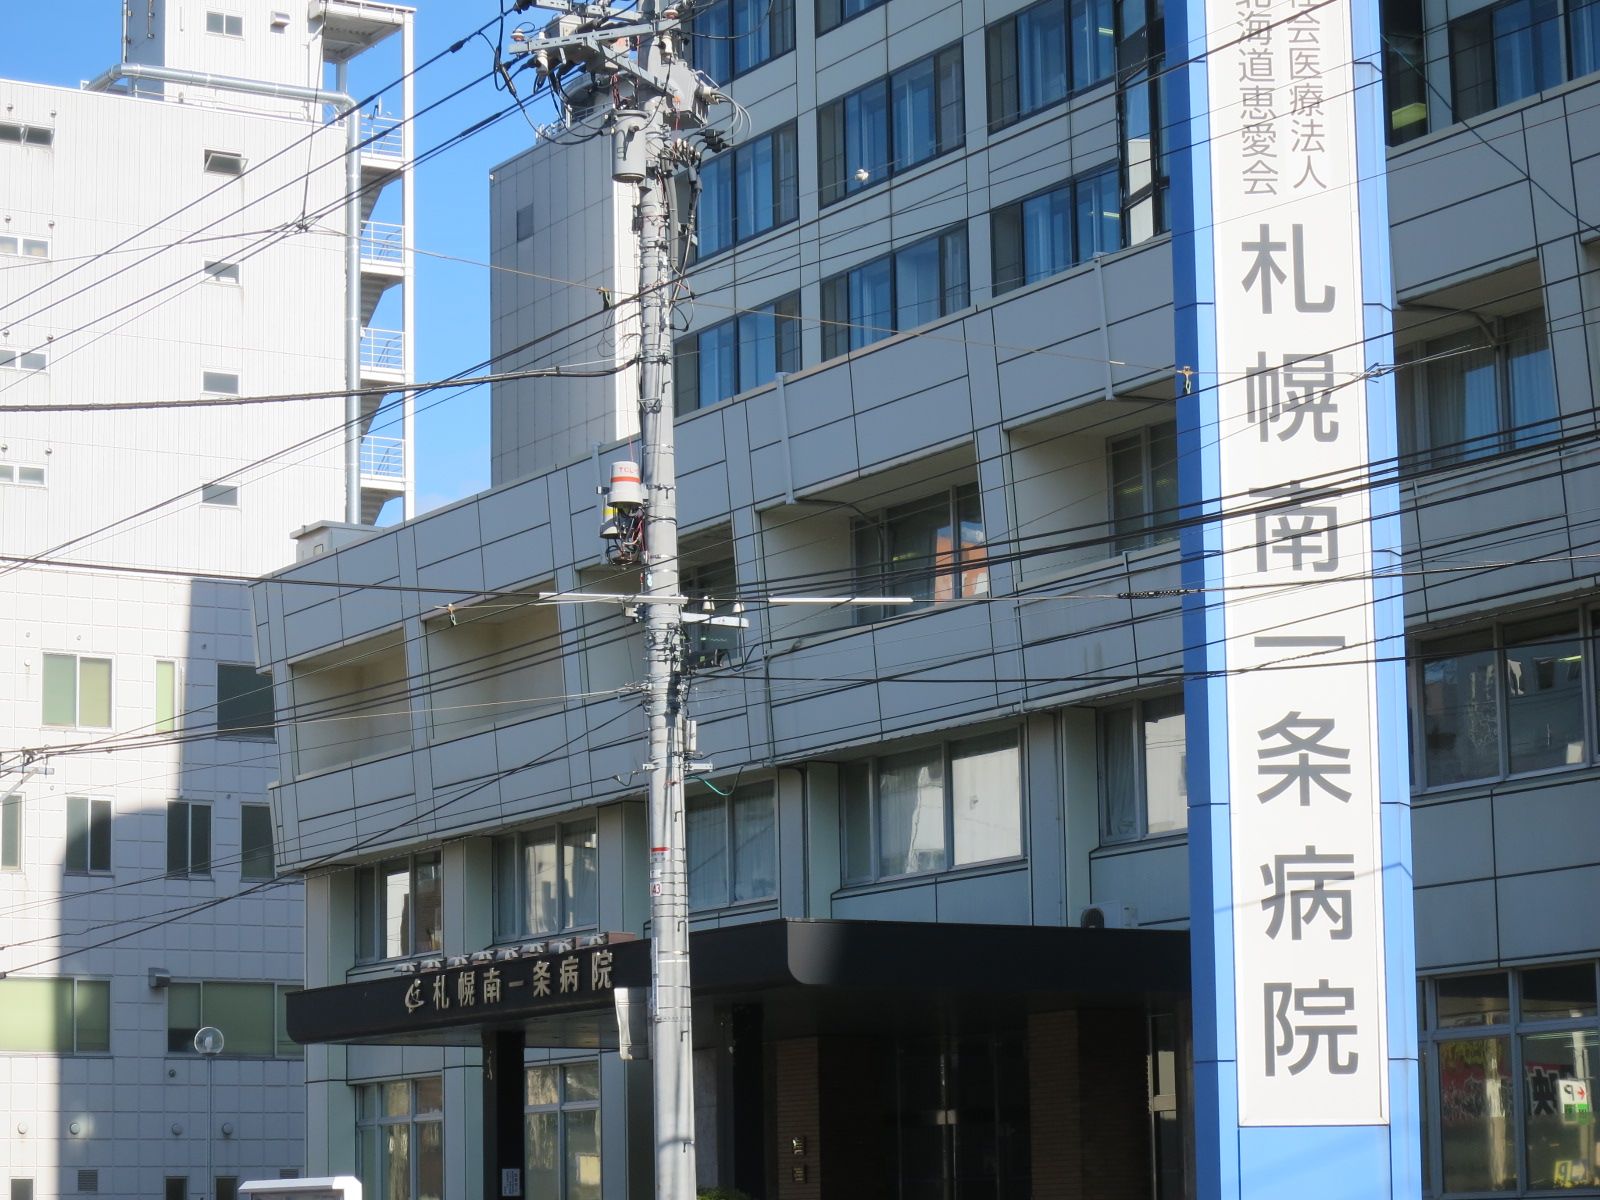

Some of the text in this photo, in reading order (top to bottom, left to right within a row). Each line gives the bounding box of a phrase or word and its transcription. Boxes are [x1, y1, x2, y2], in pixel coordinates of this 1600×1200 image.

[1236, 0, 1278, 195] 海道恵愛会
[1287, 0, 1326, 189] 会医療法人
[1241, 223, 1358, 1077] 札幌南一条病院
[432, 949, 613, 1011] 札幌南一条病院
